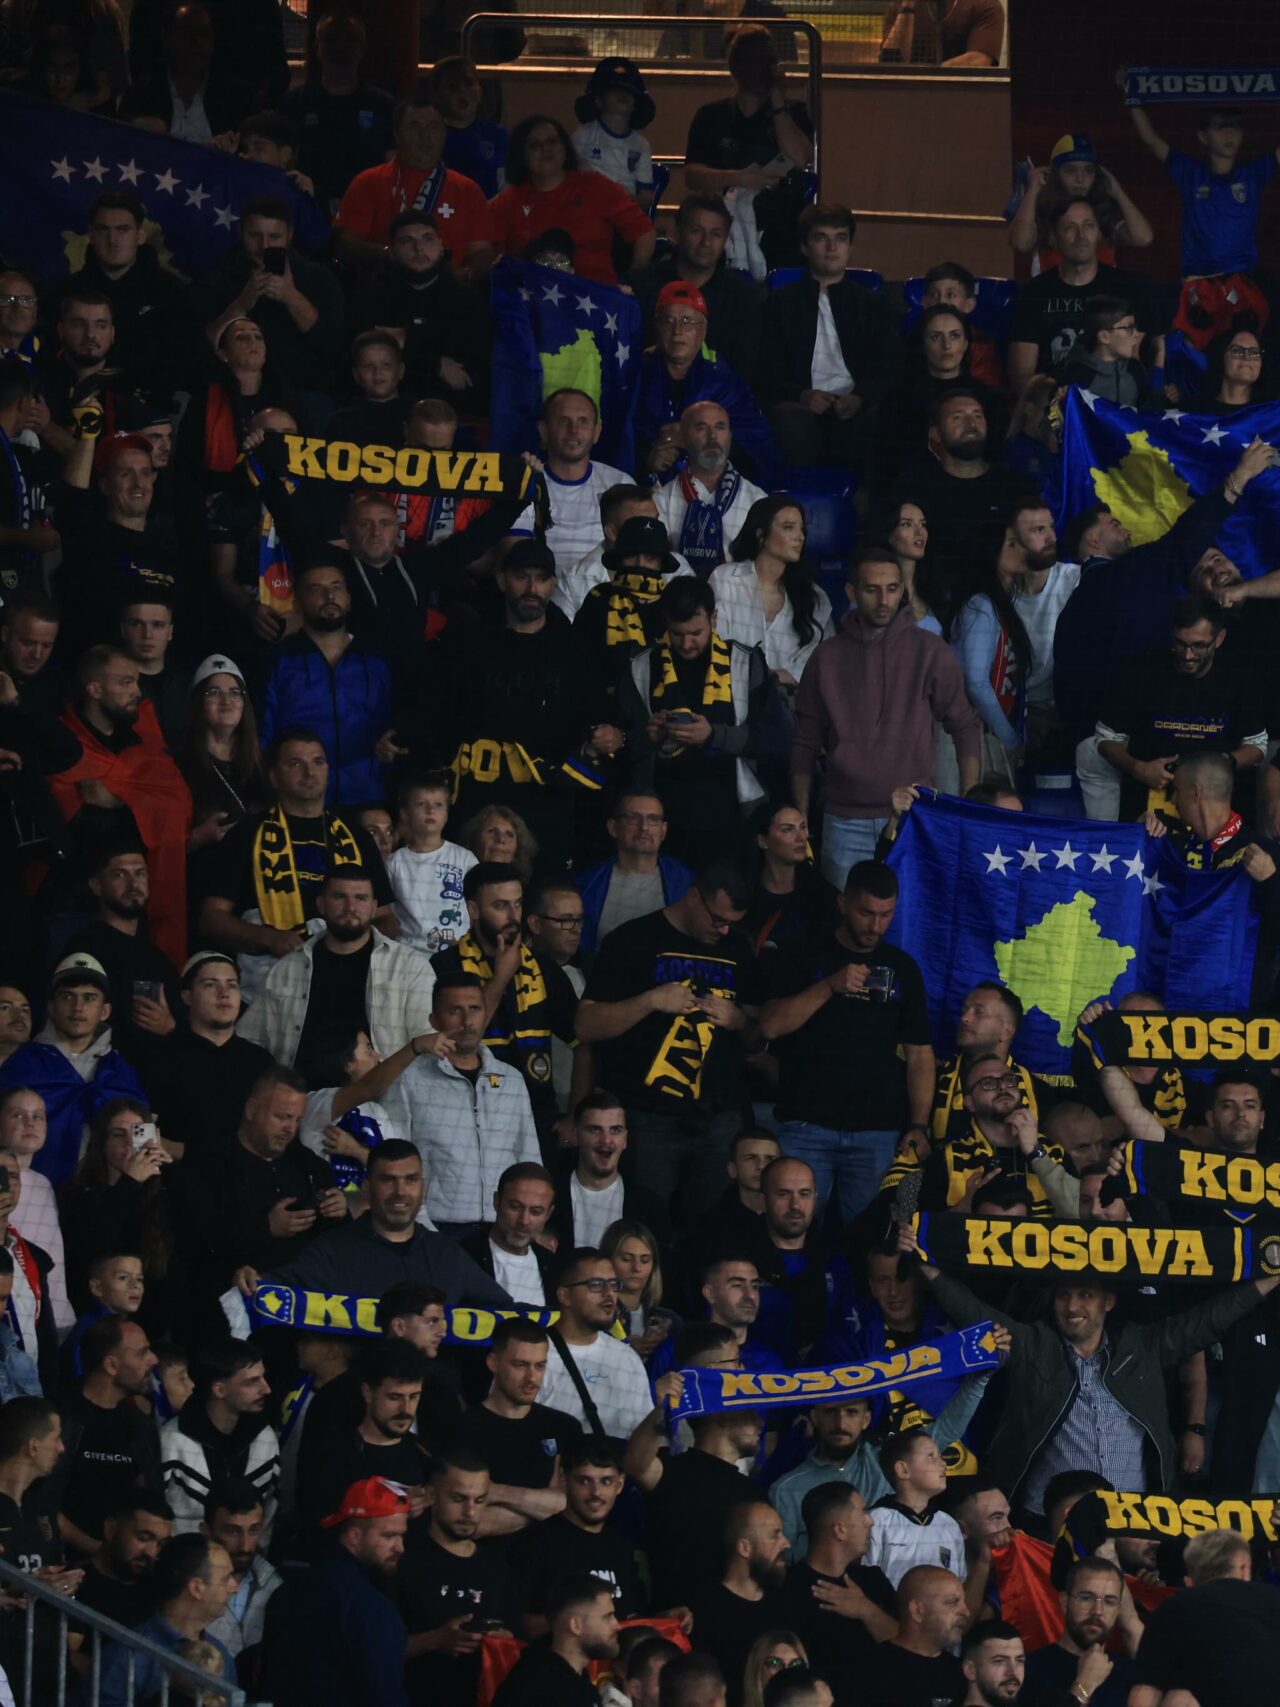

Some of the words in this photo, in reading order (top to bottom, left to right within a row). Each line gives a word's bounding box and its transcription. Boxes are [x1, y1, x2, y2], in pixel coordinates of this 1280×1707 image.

[1136, 73, 1276, 95] KOSOVA
[285, 436, 504, 492] KOSOVA
[966, 1220, 1213, 1276] KOSOVA
[723, 1347, 942, 1396] KOSOVA
[84, 1451, 133, 1464] GIVENCHY
[1097, 1490, 1278, 1542] KOSOV
